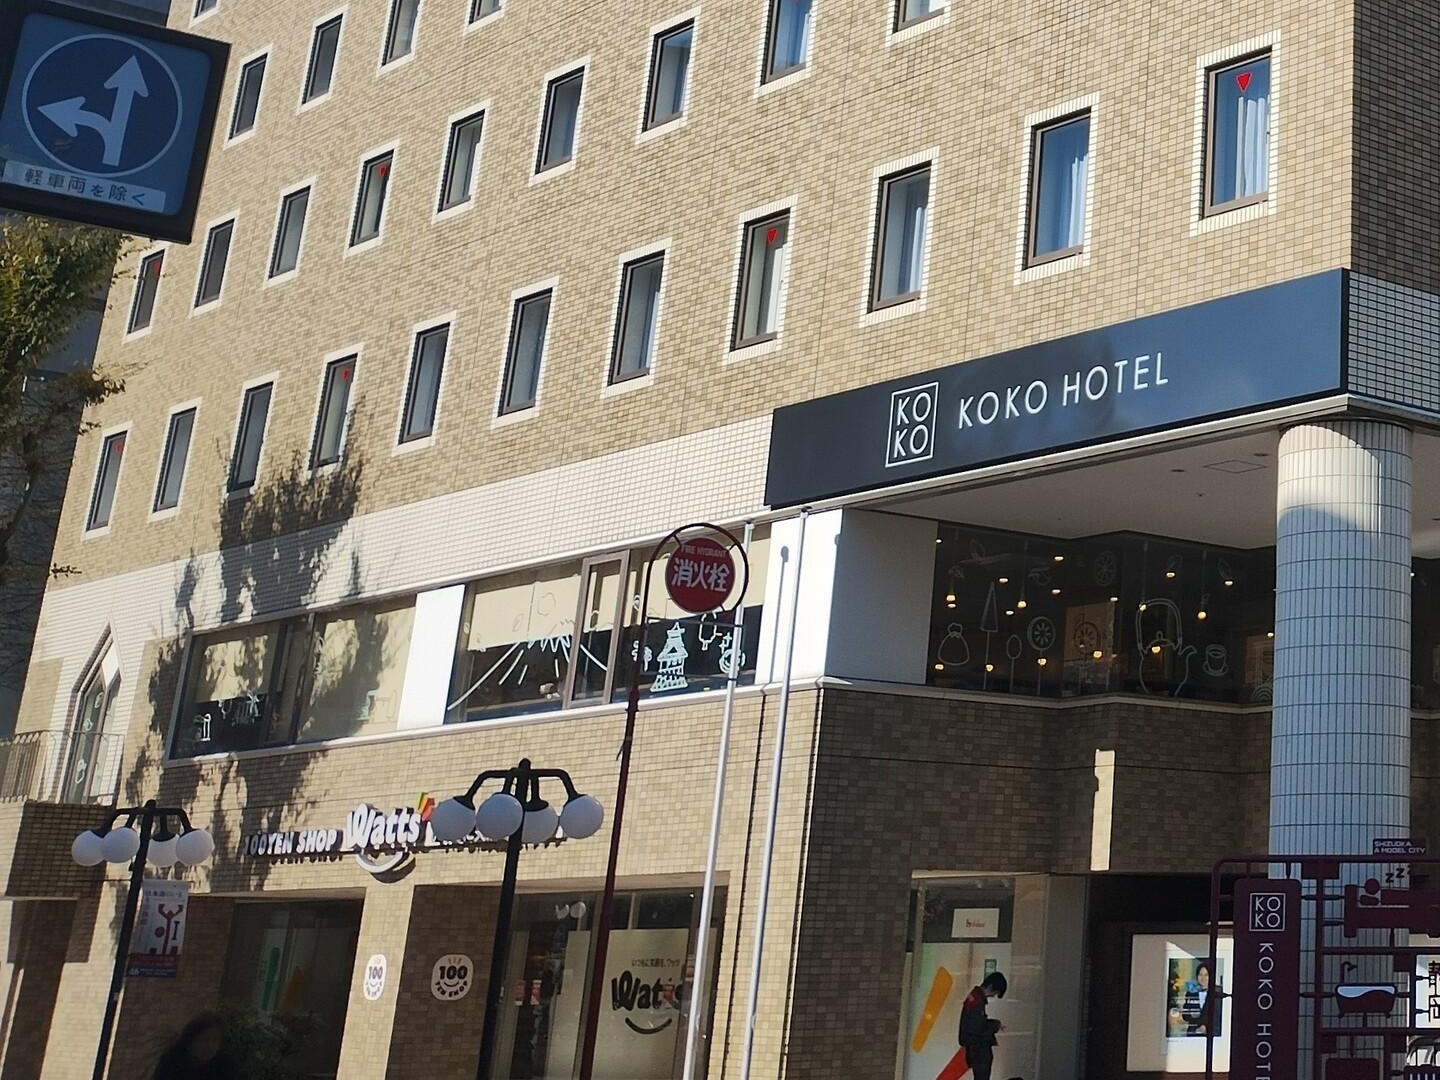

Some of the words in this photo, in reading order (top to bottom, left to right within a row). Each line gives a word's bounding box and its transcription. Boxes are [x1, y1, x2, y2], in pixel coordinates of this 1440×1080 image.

[24, 168, 146, 206] 軽車両を除く
[958, 380, 1048, 429] KOKO
[1061, 352, 1169, 407] HOTEL
[896, 392, 932, 427] KO
[893, 424, 929, 459] KO
[671, 557, 730, 592] 消火栓
[296, 828, 338, 855] SHOP
[1254, 912, 1281, 928] KO
[1255, 896, 1281, 912] KO
[368, 966, 384, 980] 100
[439, 965, 468, 980] 100
[1257, 942, 1274, 1010] KOKO
